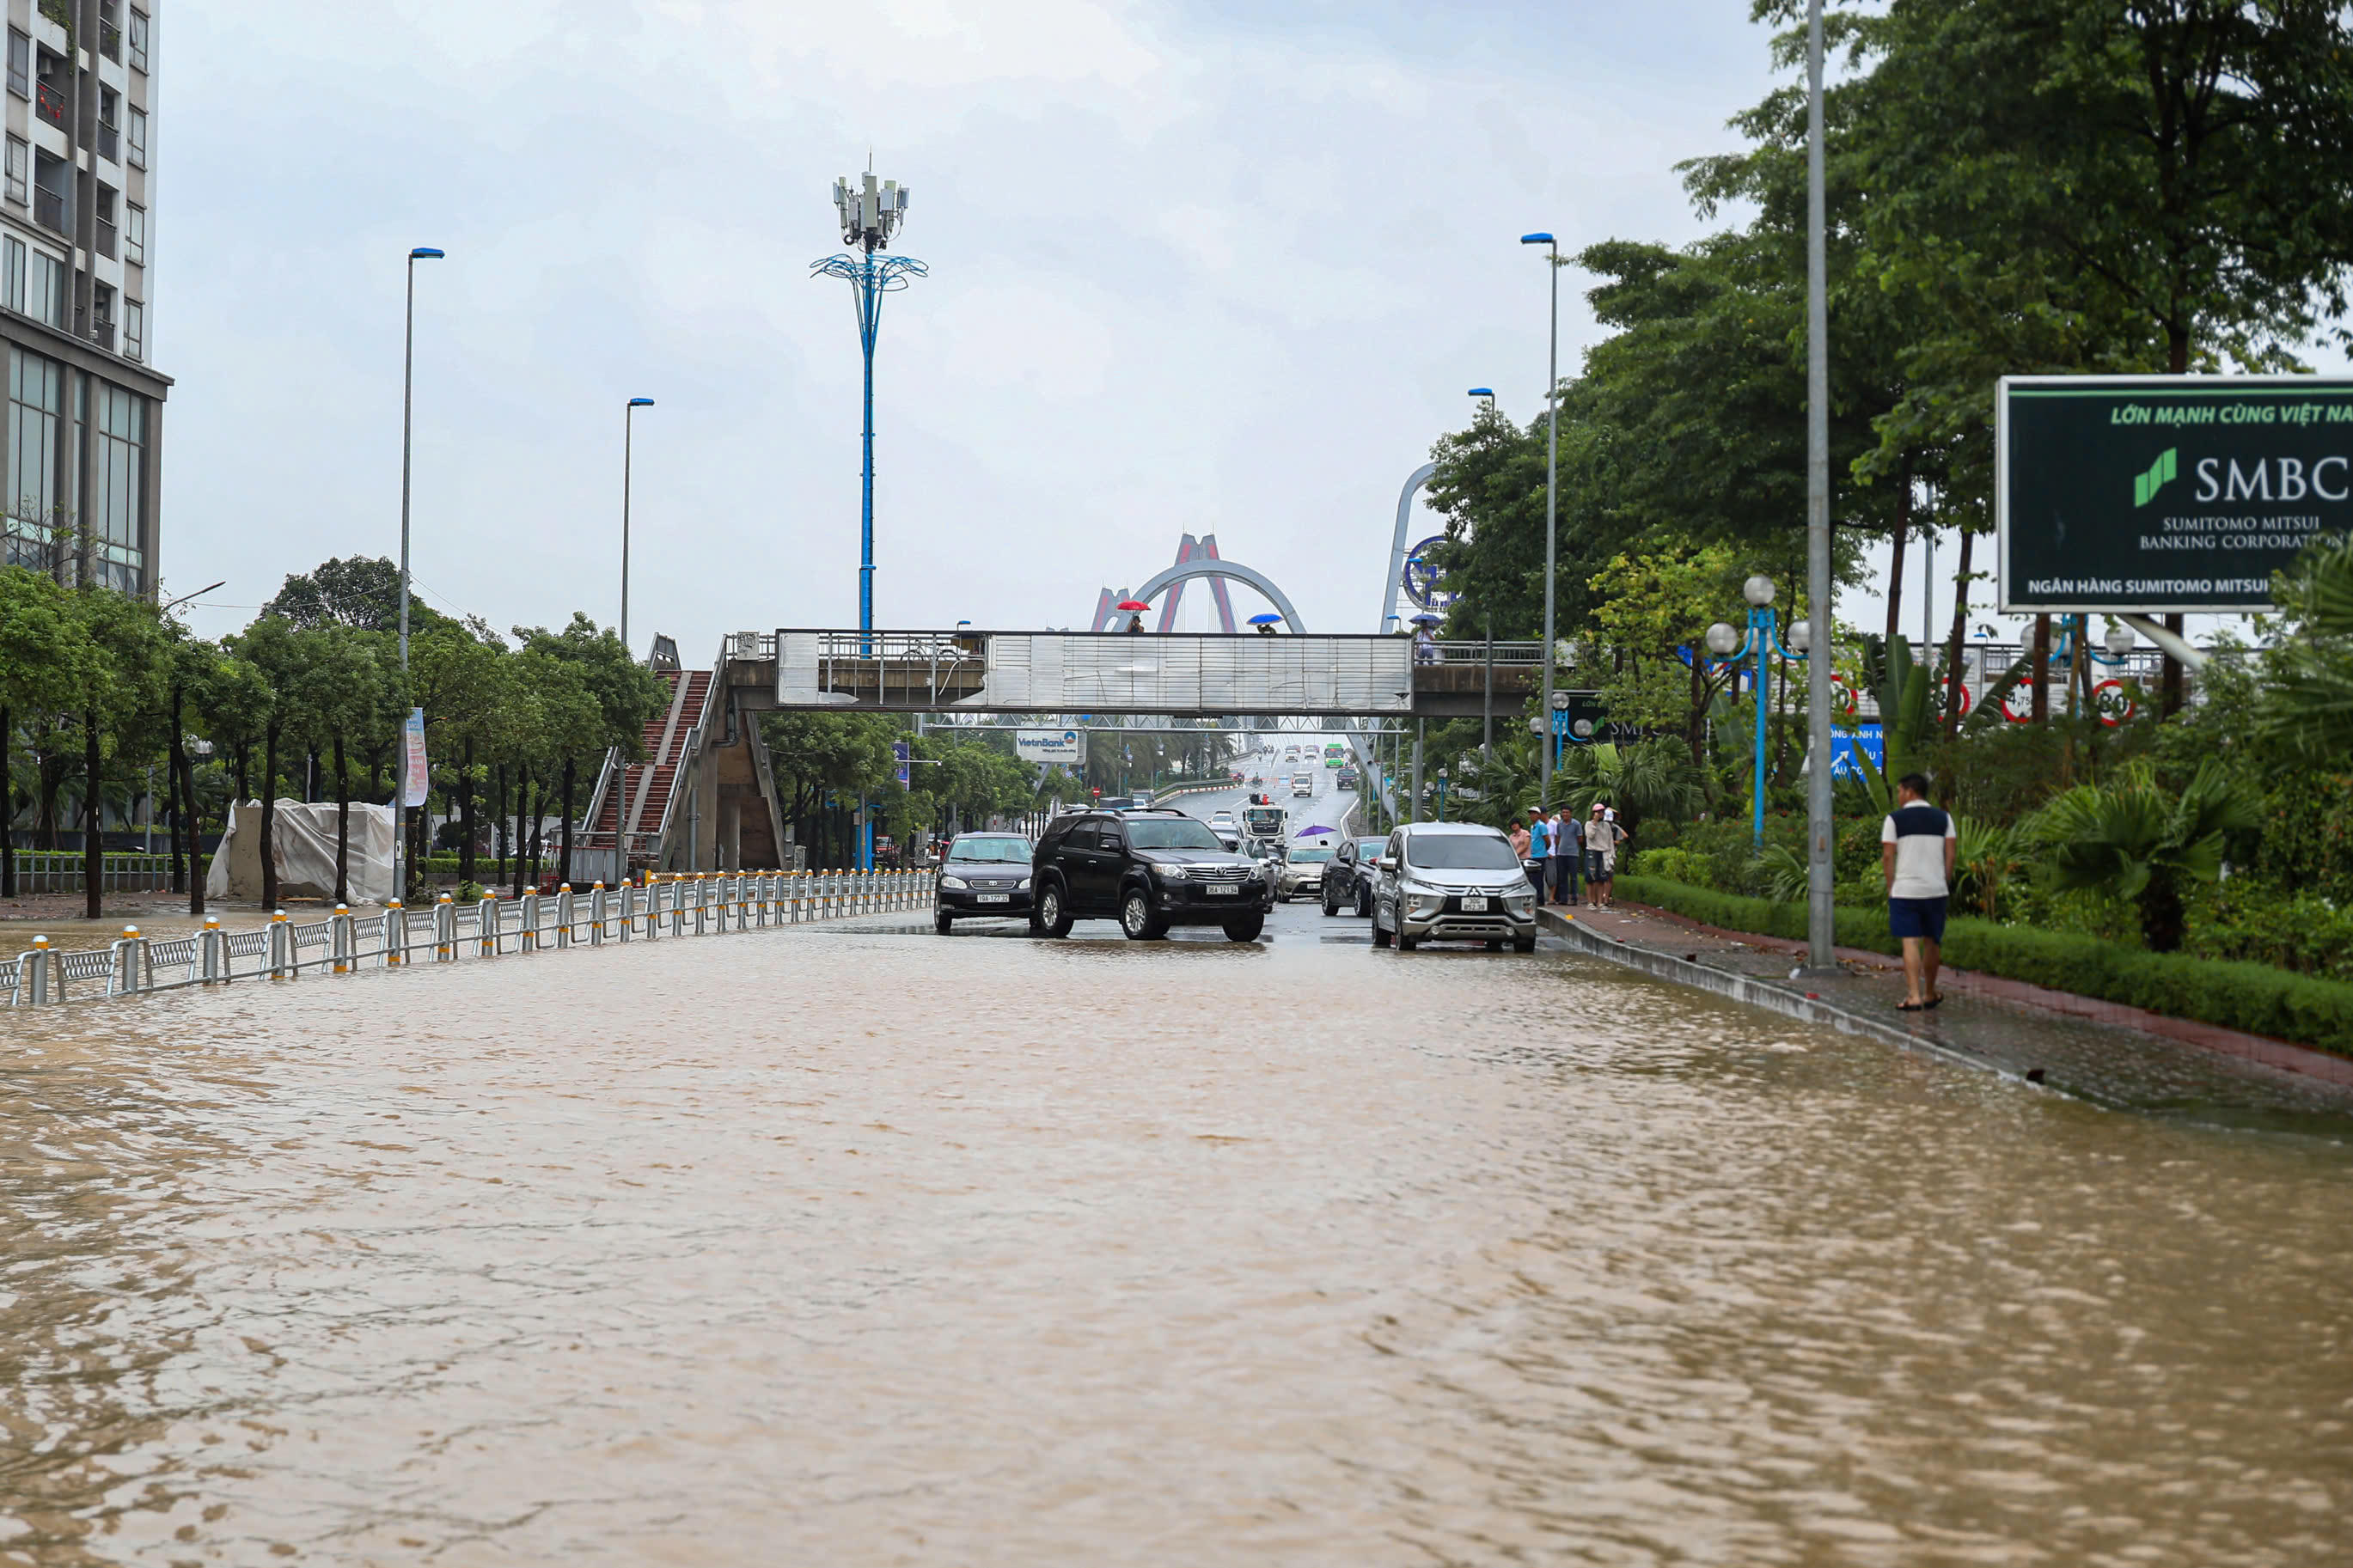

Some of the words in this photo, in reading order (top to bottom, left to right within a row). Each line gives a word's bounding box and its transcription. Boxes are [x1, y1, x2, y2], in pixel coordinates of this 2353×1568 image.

[2110, 404, 2151, 424] LỚN
[2154, 406, 2215, 428] MẠNH
[2220, 403, 2276, 424] CÙNG
[2280, 403, 2323, 427] VIỆT
[2195, 456, 2350, 502] SMBC
[2163, 516, 2258, 532] SUMITOMO
[2262, 516, 2320, 531] MITSUI
[2140, 534, 2216, 551] BANKING
[2028, 577, 2074, 595] NGÂN
[2076, 577, 2123, 594] HÀNG
[2125, 579, 2212, 594] SUMITOMO
[2215, 578, 2269, 593] MITSUI
[2008, 690, 2033, 708] 4,75
[2099, 692, 2127, 713] 80
[1018, 738, 1066, 747] VietinBank
[1830, 729, 1849, 739] NG
